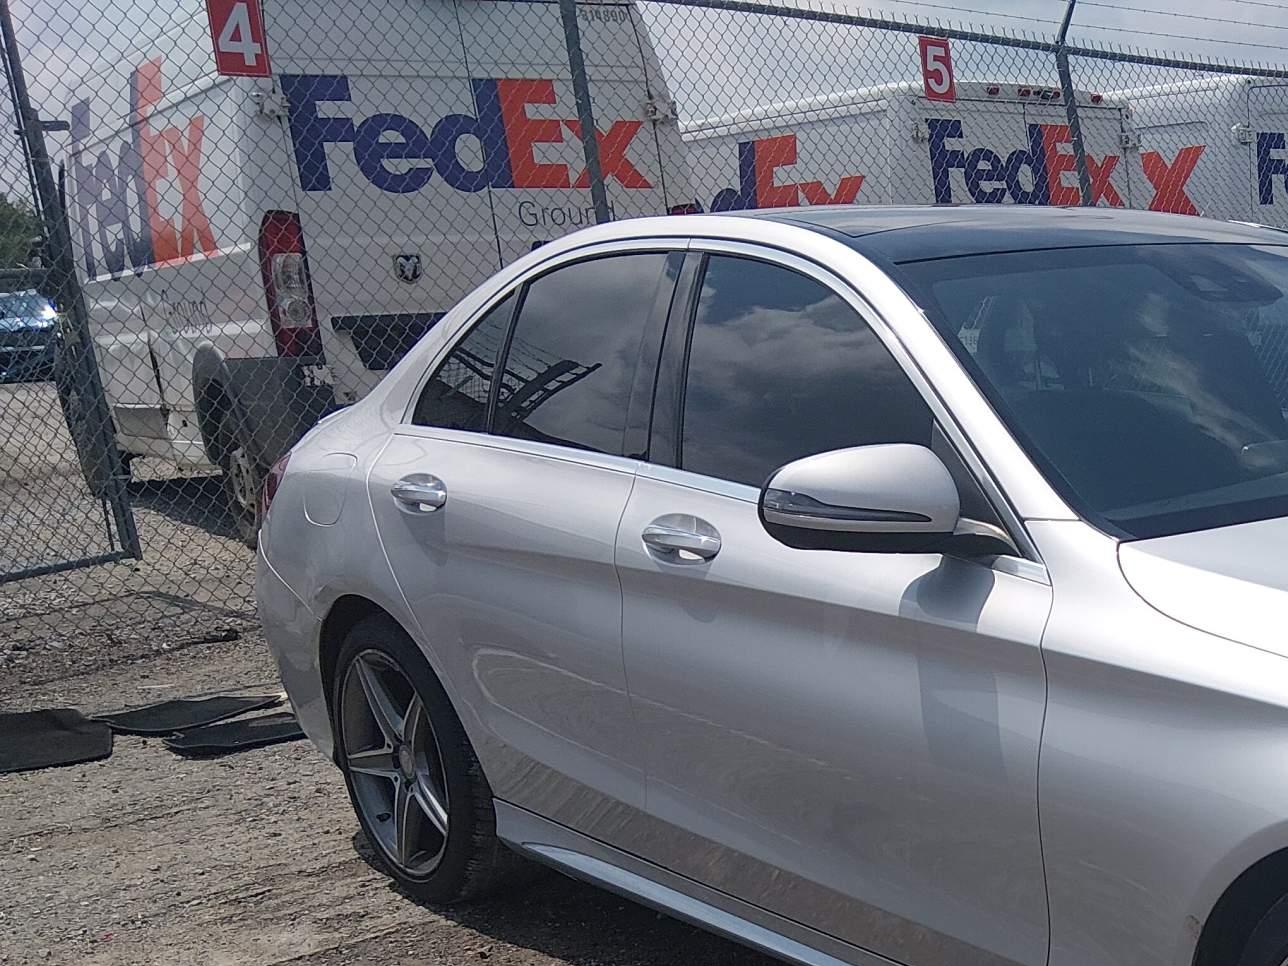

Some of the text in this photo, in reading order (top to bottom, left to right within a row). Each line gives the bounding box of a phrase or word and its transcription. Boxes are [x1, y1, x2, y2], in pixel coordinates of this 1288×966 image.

[218, 2, 261, 66] 4
[926, 45, 951, 95] 5
[71, 55, 220, 282] FedEx
[280, 74, 655, 193] FedEx
[925, 118, 1125, 207] FedEx
